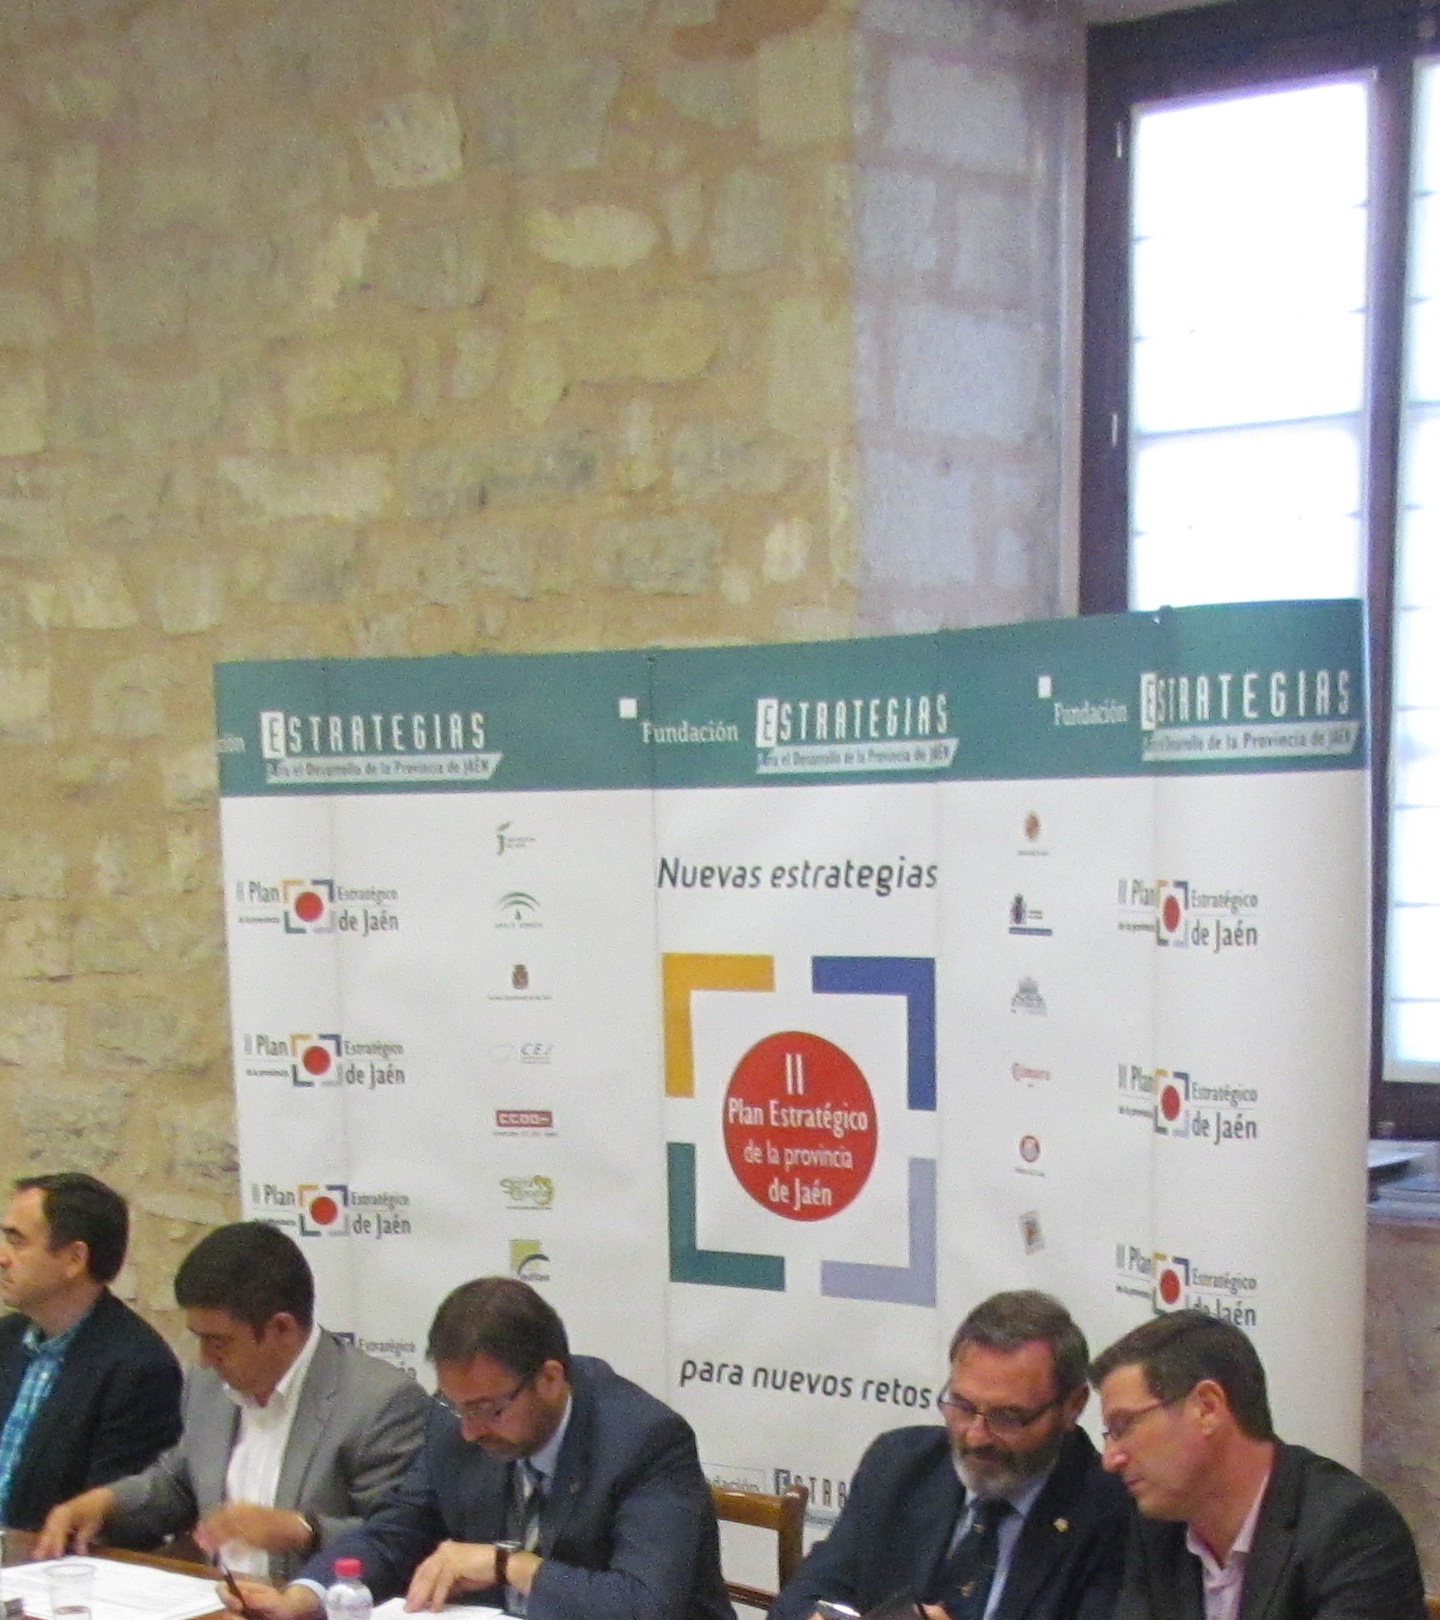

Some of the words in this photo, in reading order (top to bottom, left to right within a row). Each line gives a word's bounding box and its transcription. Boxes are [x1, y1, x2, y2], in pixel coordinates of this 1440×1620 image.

[263, 711, 486, 757] ESTRATEGIAS
[641, 720, 738, 744] Fundación
[756, 694, 948, 747] ESTRATEGIAS
[1243, 731, 1307, 748] Provincia
[249, 880, 279, 902] Plan
[337, 885, 399, 904] Estratégico
[657, 857, 761, 889] Nuevas
[770, 856, 938, 896] estrategias
[338, 909, 358, 931] de
[362, 908, 399, 937] Jaén
[1191, 919, 1210, 946] de
[1213, 919, 1258, 954] Jaén
[256, 1034, 288, 1056] Plan
[344, 1040, 404, 1059] Estratégico
[346, 1063, 365, 1085] de
[369, 1063, 406, 1090] Jaén
[785, 1053, 804, 1095] II
[727, 1097, 765, 1126] Plan
[769, 1099, 868, 1138] Estratégico
[1191, 1110, 1210, 1137] de
[1213, 1111, 1257, 1145] Jaén
[744, 1140, 764, 1164] de
[766, 1140, 780, 1165] la
[784, 1142, 854, 1171] provincia
[264, 1184, 295, 1206] Plan
[352, 1191, 409, 1210] Estratégico
[768, 1178, 791, 1204] de
[794, 1177, 832, 1211] Jaén
[353, 1213, 372, 1234] de
[375, 1212, 411, 1239] Jaén
[680, 1358, 744, 1387] para
[752, 1366, 854, 1398] nuevos
[862, 1377, 933, 1410] retos
